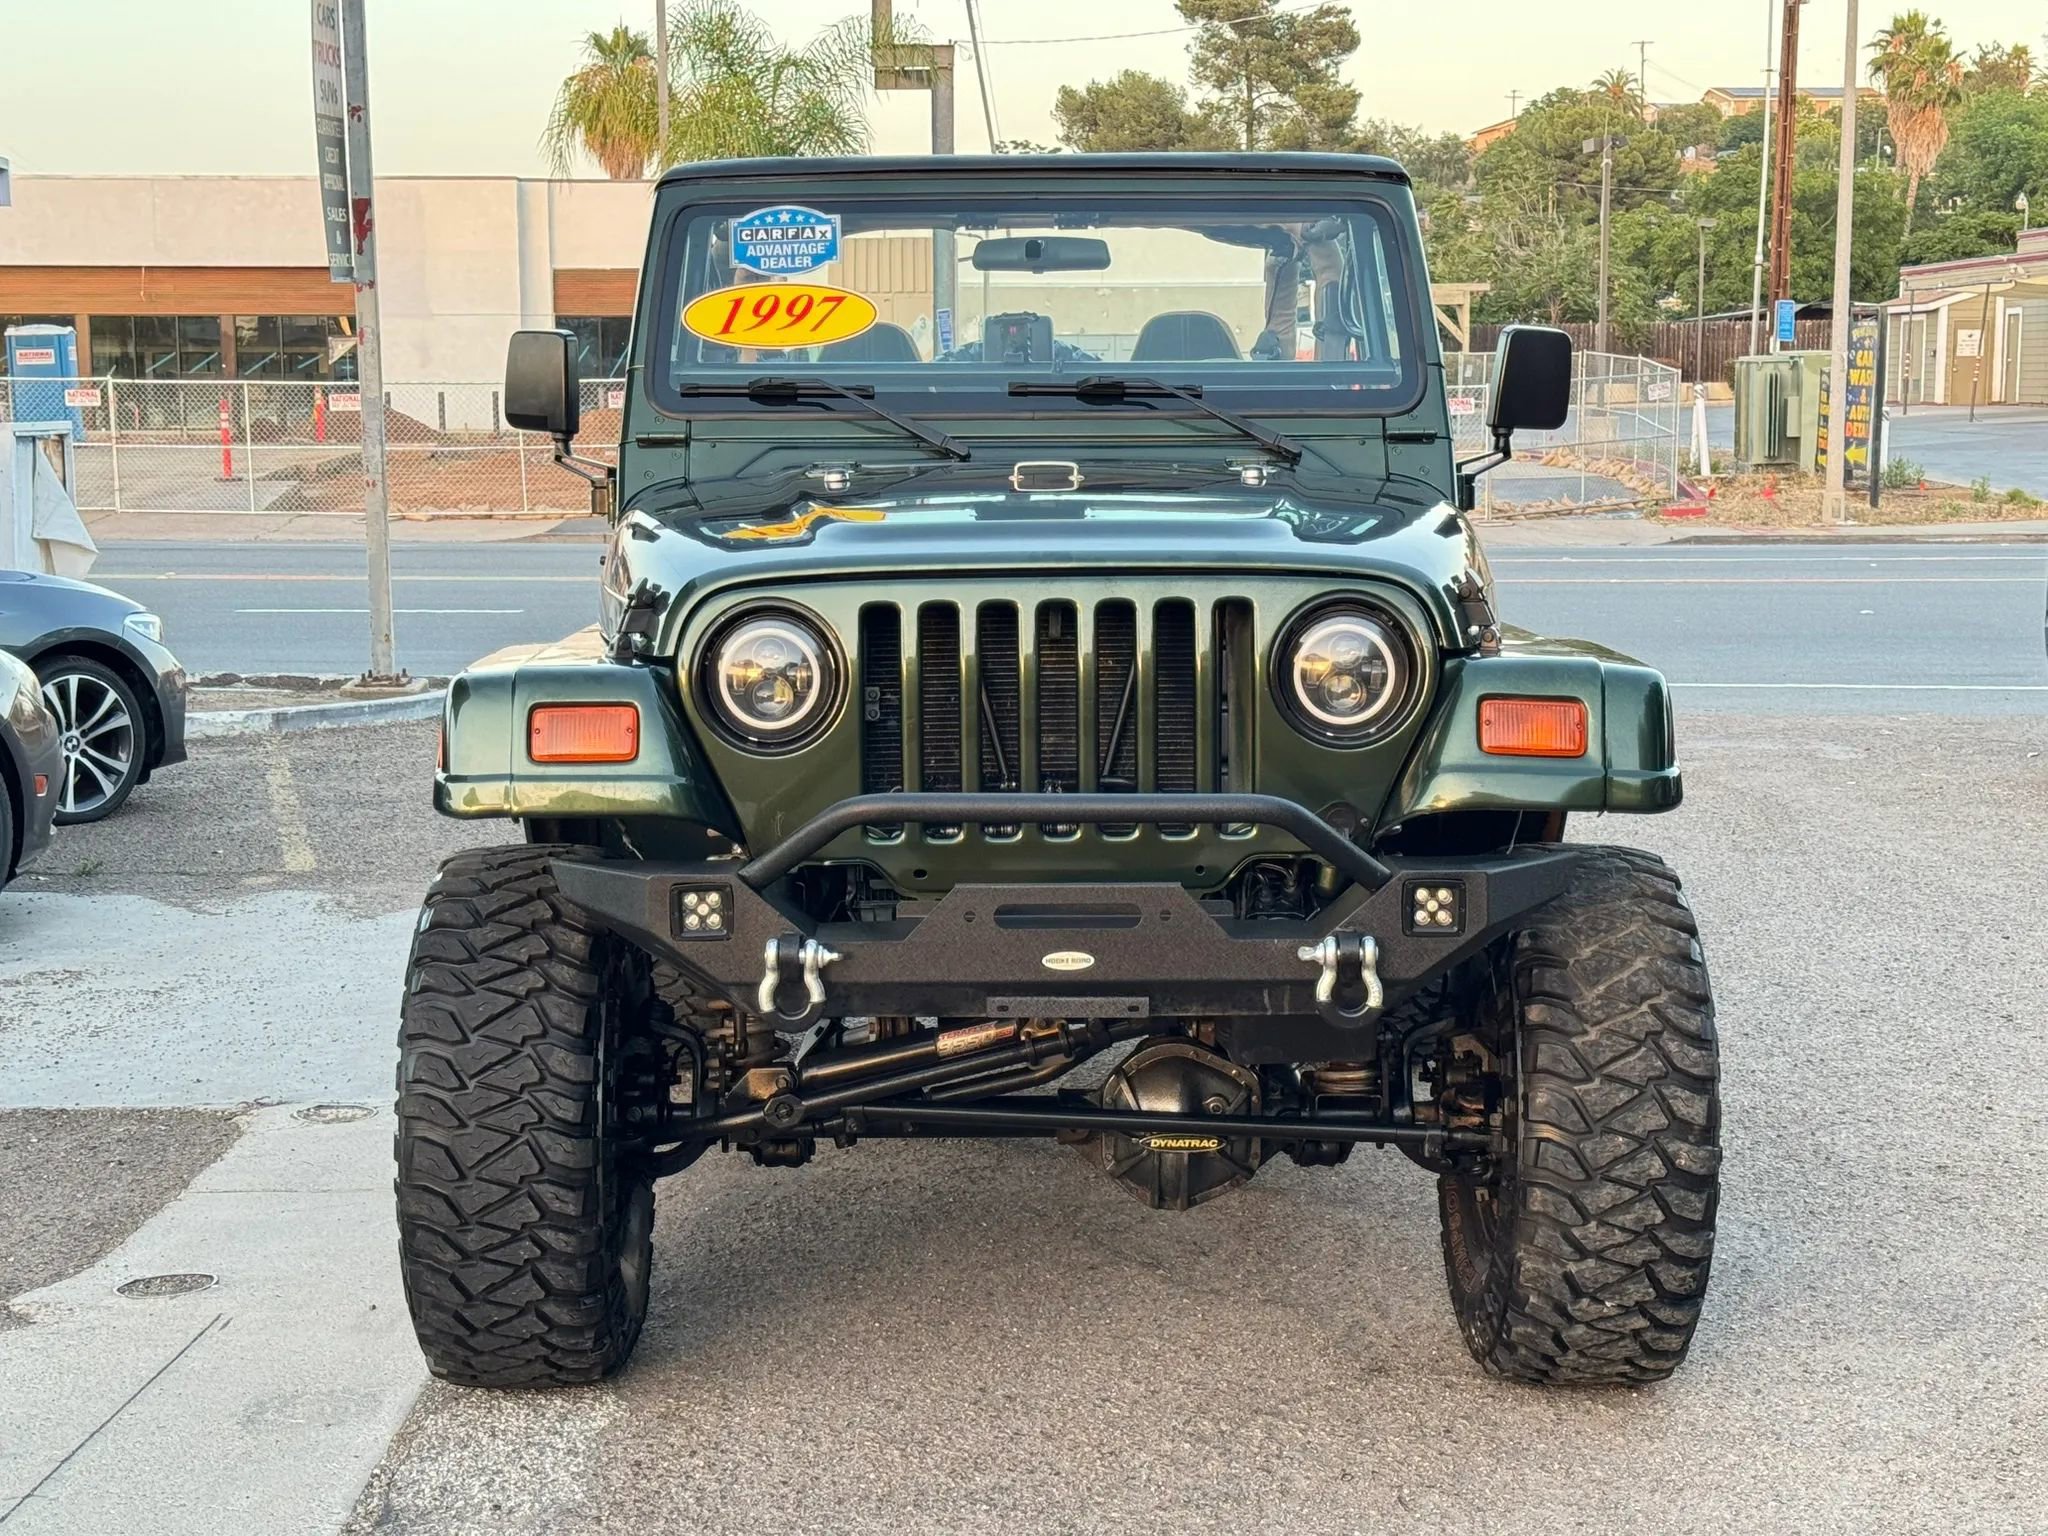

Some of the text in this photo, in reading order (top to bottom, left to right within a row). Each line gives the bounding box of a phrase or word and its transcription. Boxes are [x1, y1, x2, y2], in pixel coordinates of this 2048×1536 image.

[316, 4, 336, 29] CARS
[313, 40, 341, 68] TRUCKS
[326, 206, 347, 222] SALES
[740, 227, 831, 242] CARFAX
[746, 242, 827, 257] ADVANTAGE
[760, 256, 812, 269] DEALER
[714, 293, 848, 336] 1997
[1150, 1139, 1218, 1148] DYNATRAC
